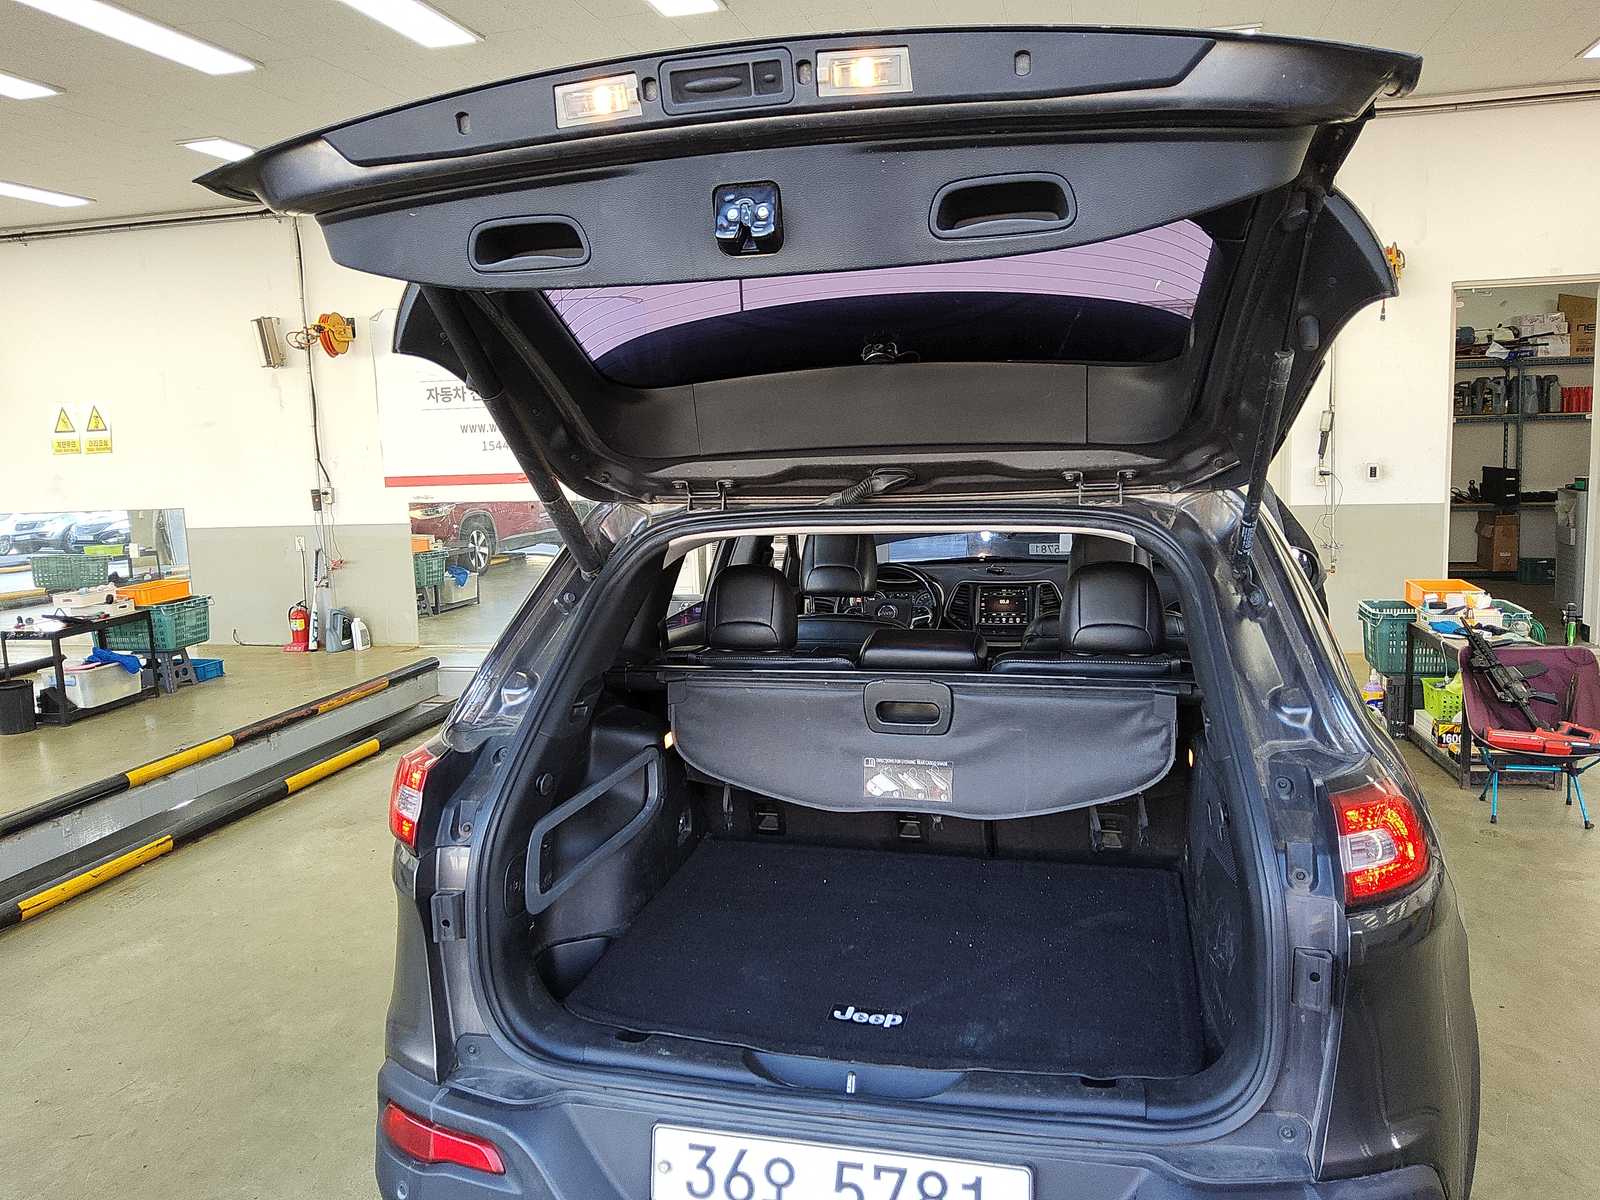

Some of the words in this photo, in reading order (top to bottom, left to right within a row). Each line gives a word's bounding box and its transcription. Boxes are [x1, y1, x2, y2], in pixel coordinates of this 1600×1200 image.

[426, 386, 466, 403] 자동차
[1442, 733, 1461, 744] 160
[833, 1006, 903, 1028] Jeep
